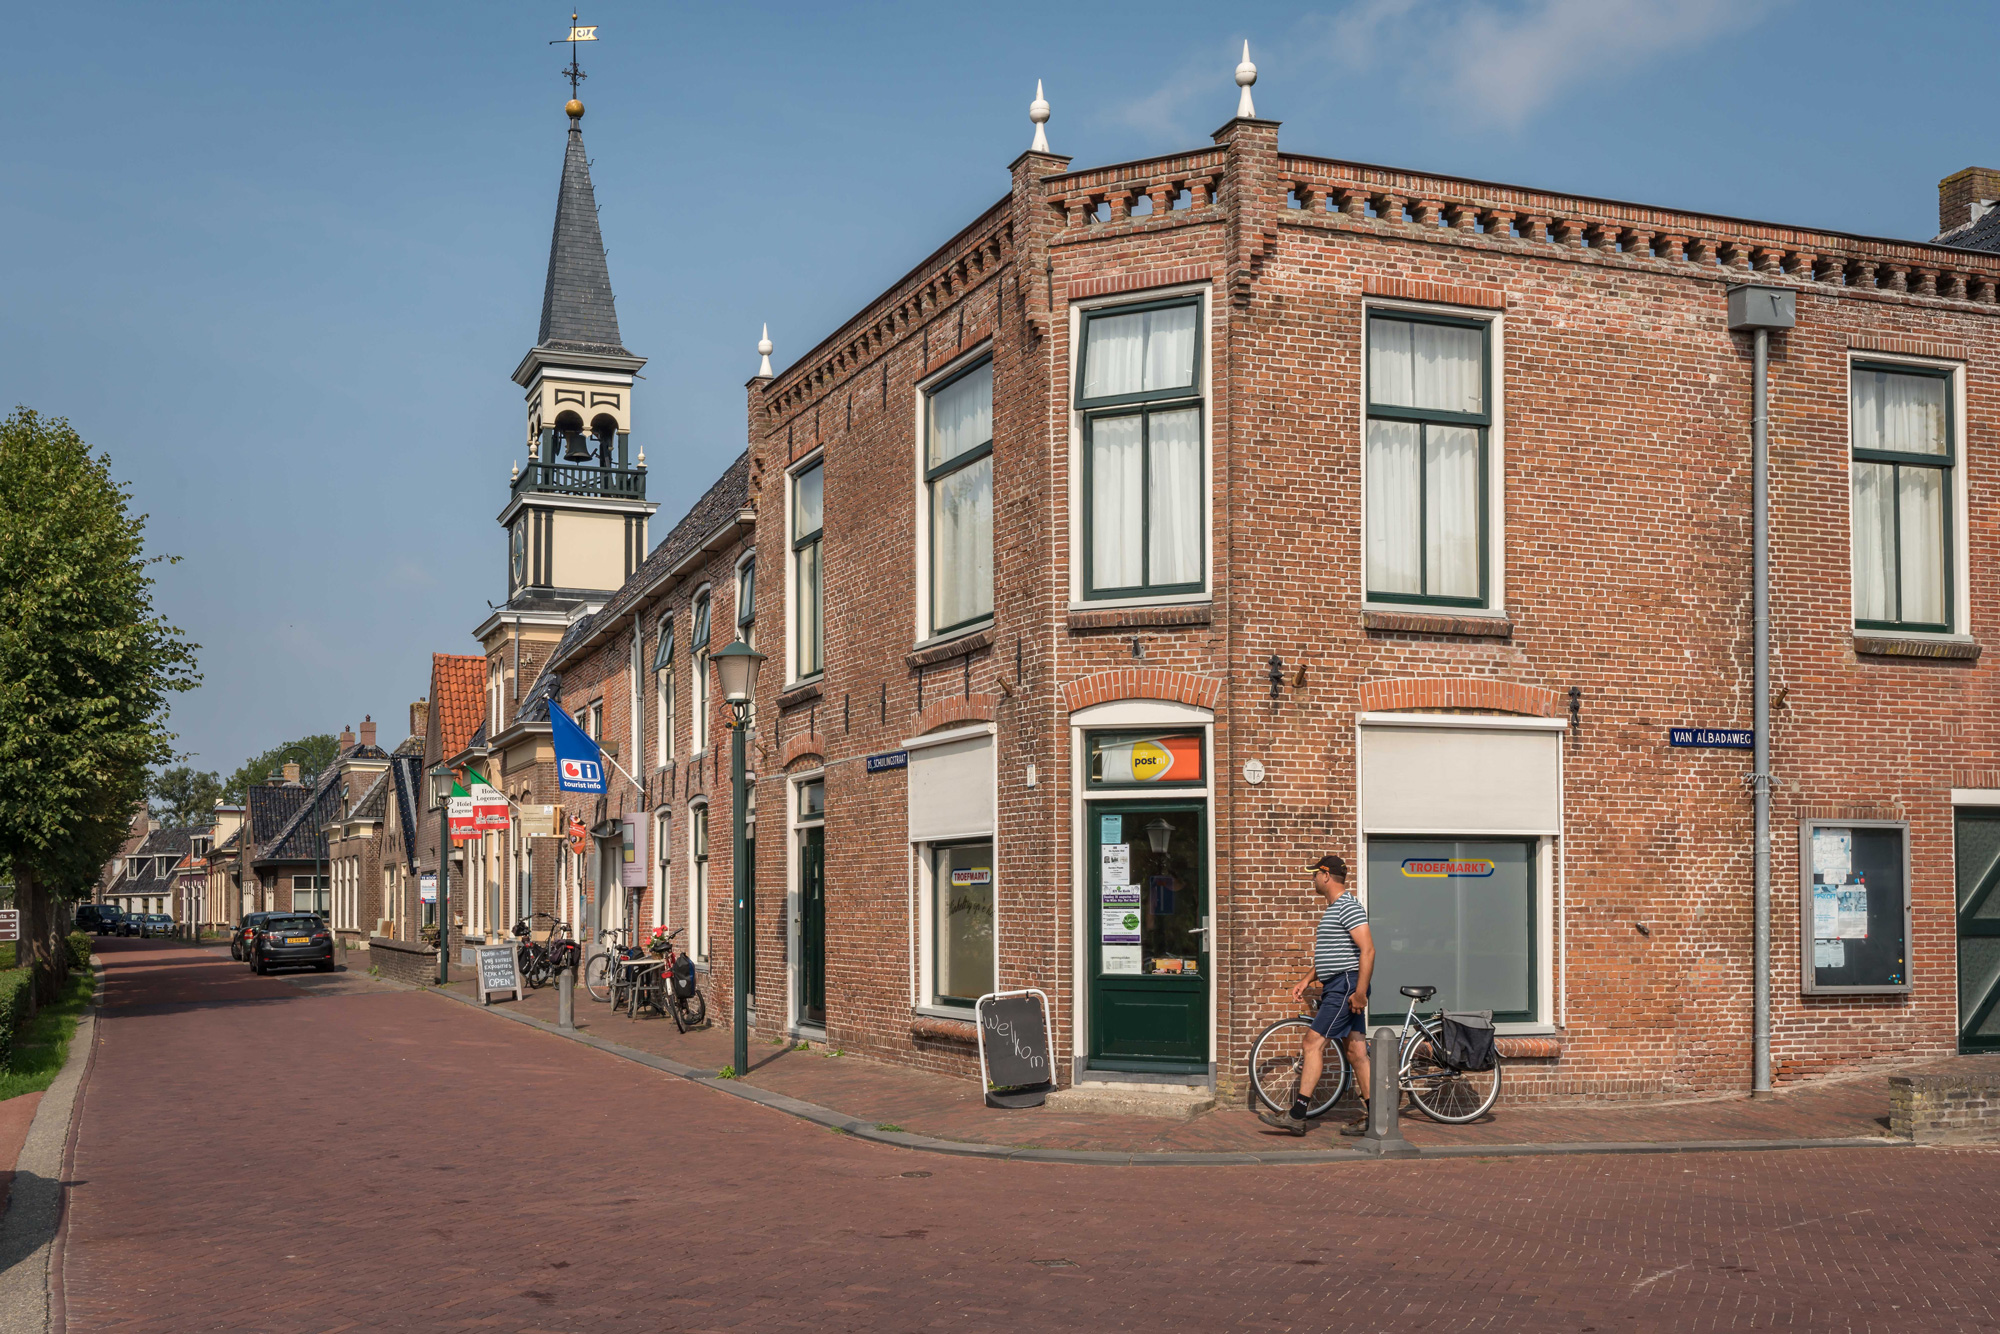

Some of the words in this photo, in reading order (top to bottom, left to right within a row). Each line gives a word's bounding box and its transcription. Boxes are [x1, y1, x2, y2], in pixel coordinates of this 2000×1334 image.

[1673, 731, 1692, 743] VAN
[1696, 732, 1751, 744] ALBADAWEG
[1134, 756, 1166, 767] postnl
[564, 781, 586, 789] tourist
[1409, 862, 1486, 873] TROEFMARKT
[953, 871, 989, 881] TROEFMARKT
[488, 978, 511, 987] OPEN
